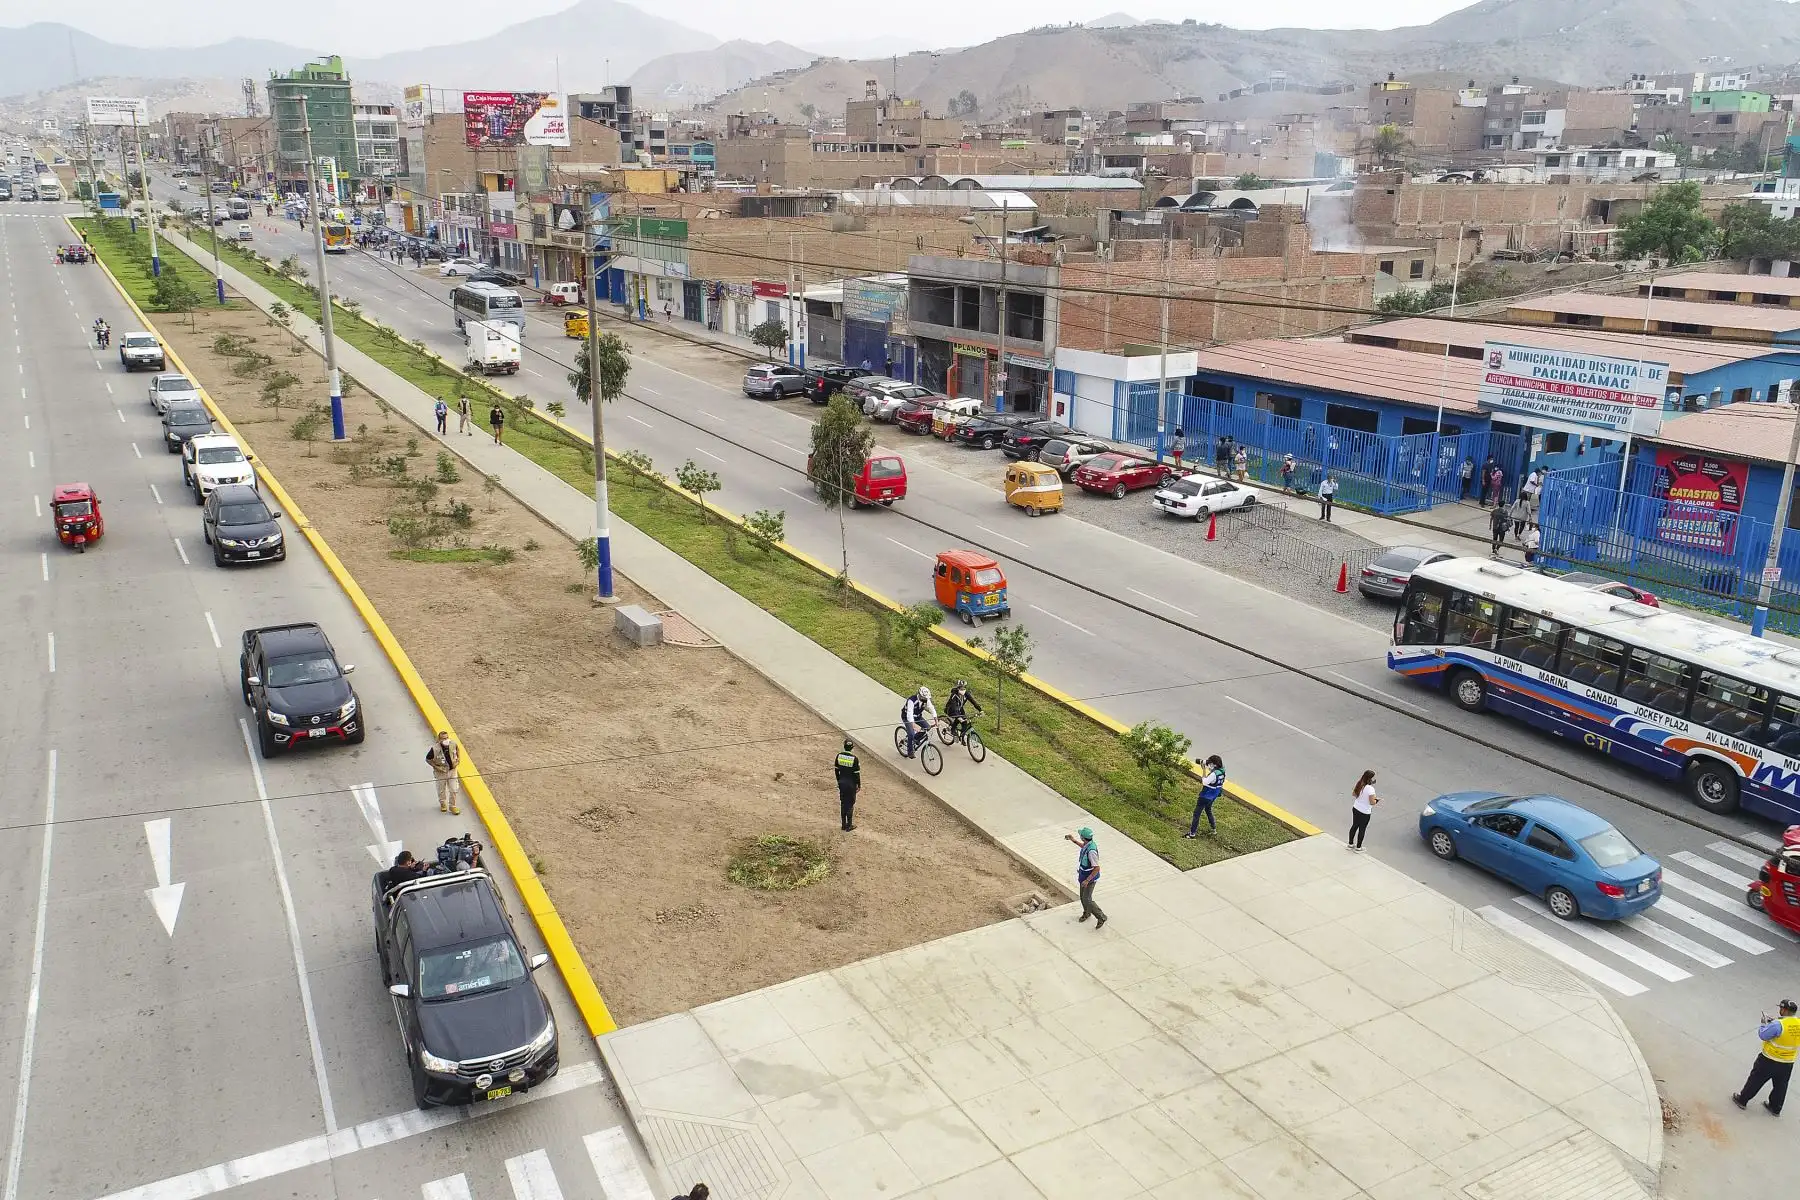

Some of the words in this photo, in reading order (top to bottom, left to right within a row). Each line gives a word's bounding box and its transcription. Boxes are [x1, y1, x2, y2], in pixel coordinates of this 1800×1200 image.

[475, 94, 487, 102] Caja
[487, 95, 512, 103] Huancayo
[958, 343, 987, 355] PLANOS
[1508, 350, 1586, 370] MUNICIPALIDAD
[1648, 368, 1663, 380] DE
[1487, 374, 1513, 386] AGENCIA
[1514, 379, 1549, 391] MUNICIPAL
[1550, 383, 1559, 392] DE
[1560, 385, 1574, 394] LOS
[1576, 387, 1607, 400] HUERTOS
[1609, 391, 1619, 400] DE
[1532, 366, 1630, 390] PACHACÁMAC
[1501, 388, 1535, 400] TRABAJO
[1537, 393, 1611, 412] DESCENTRALIZADO
[1502, 397, 1550, 412] MODERNIZAR
[1551, 406, 1588, 418] NUESTRO
[1589, 411, 1628, 425] DISTRITO
[1669, 487, 1720, 501] CATASTRO
[1494, 655, 1502, 665] LA
[1502, 658, 1523, 673] PUNTA
[1538, 671, 1569, 690] MARINA
[1585, 688, 1618, 707] CANADA
[1633, 705, 1663, 723] JOCKEY
[1664, 716, 1690, 733] PLAZA
[1583, 733, 1612, 754] CTI
[1705, 731, 1718, 743] AV.
[1719, 735, 1730, 747] LA
[1731, 739, 1764, 760] MOLINA
